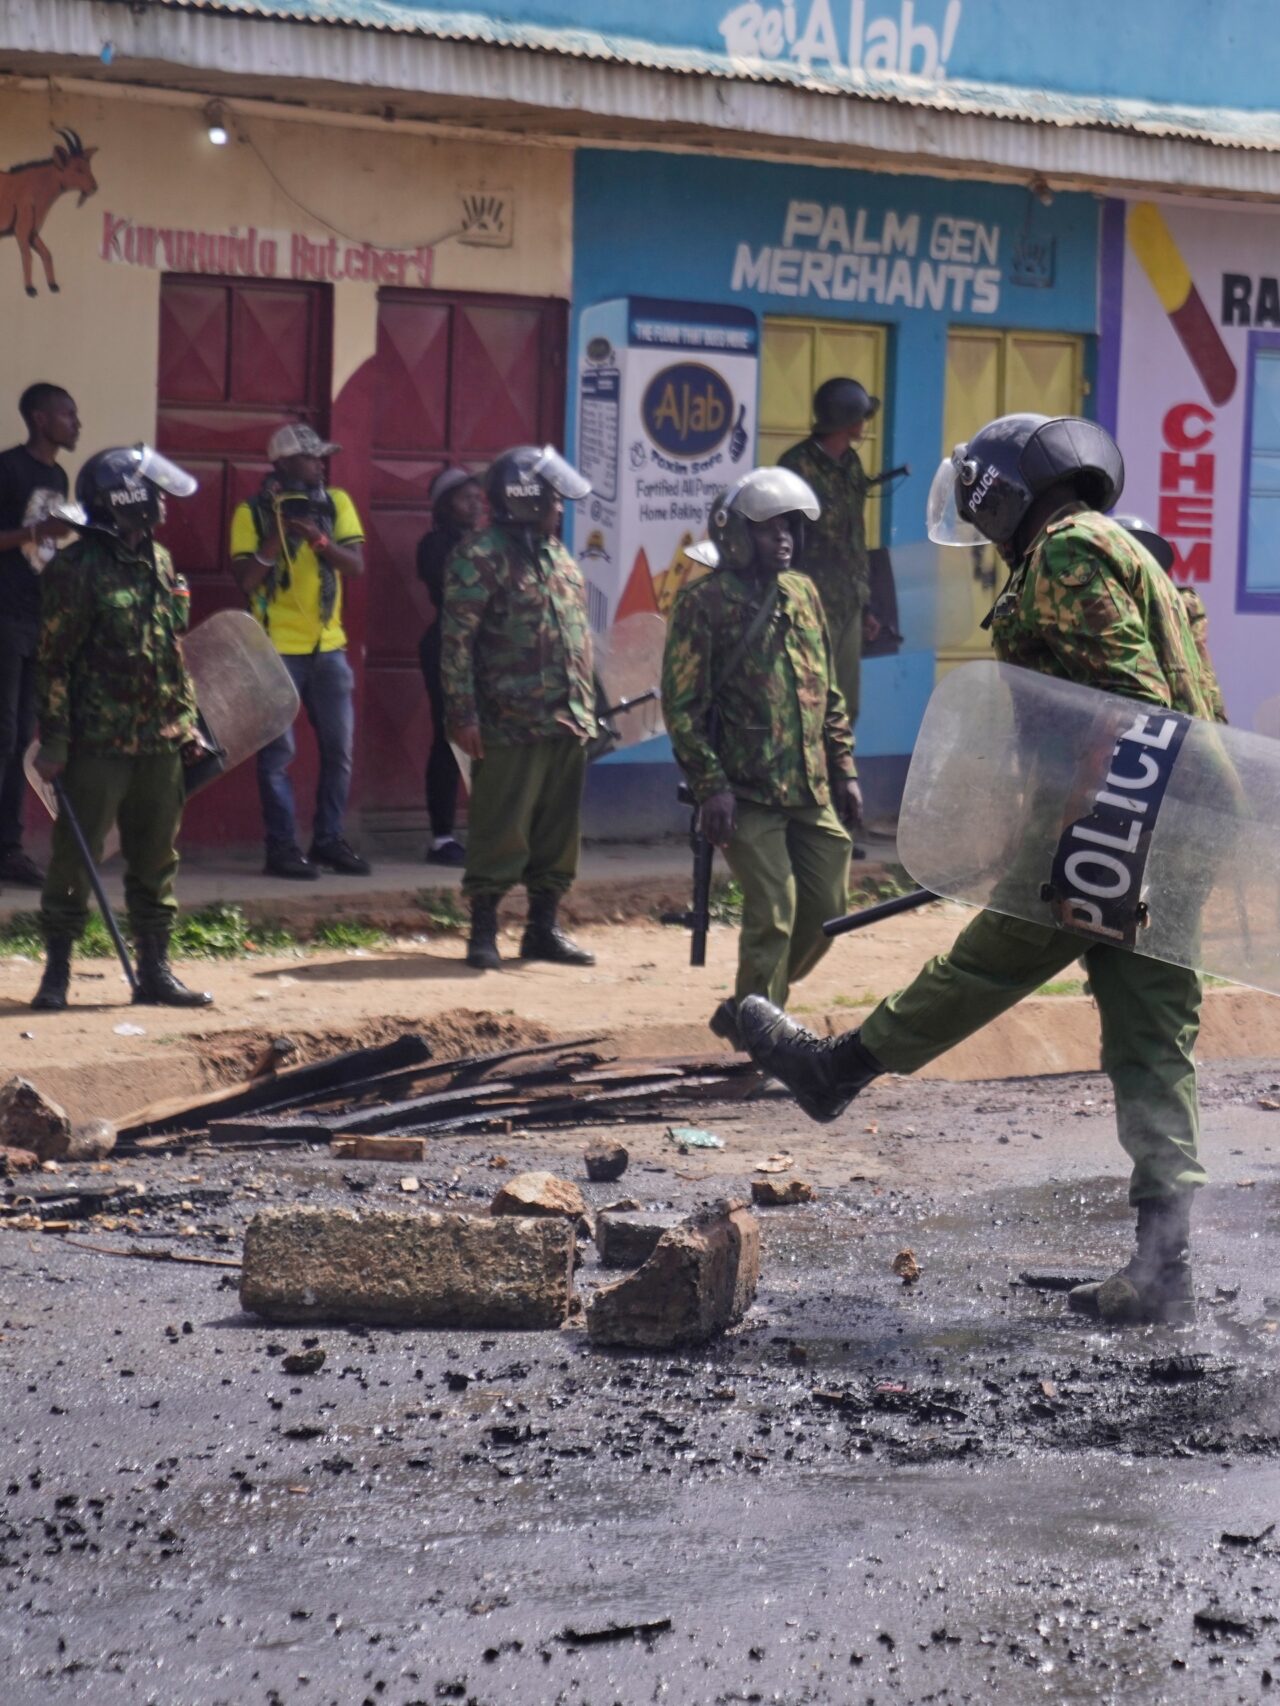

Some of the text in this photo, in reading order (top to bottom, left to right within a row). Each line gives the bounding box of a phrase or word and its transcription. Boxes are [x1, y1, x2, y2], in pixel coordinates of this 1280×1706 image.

[782, 200, 999, 267] PALM GEN
[730, 243, 1002, 314] MERCHANTS
[109, 486, 148, 507] POLICE
[505, 483, 541, 498] POLICE
[636, 478, 679, 499] Fortified
[639, 502, 668, 523] Home
[670, 501, 703, 525] Baking
[968, 463, 1000, 513] POLICE
[1158, 403, 1216, 584] CHEM
[1062, 713, 1178, 941] POLICE
